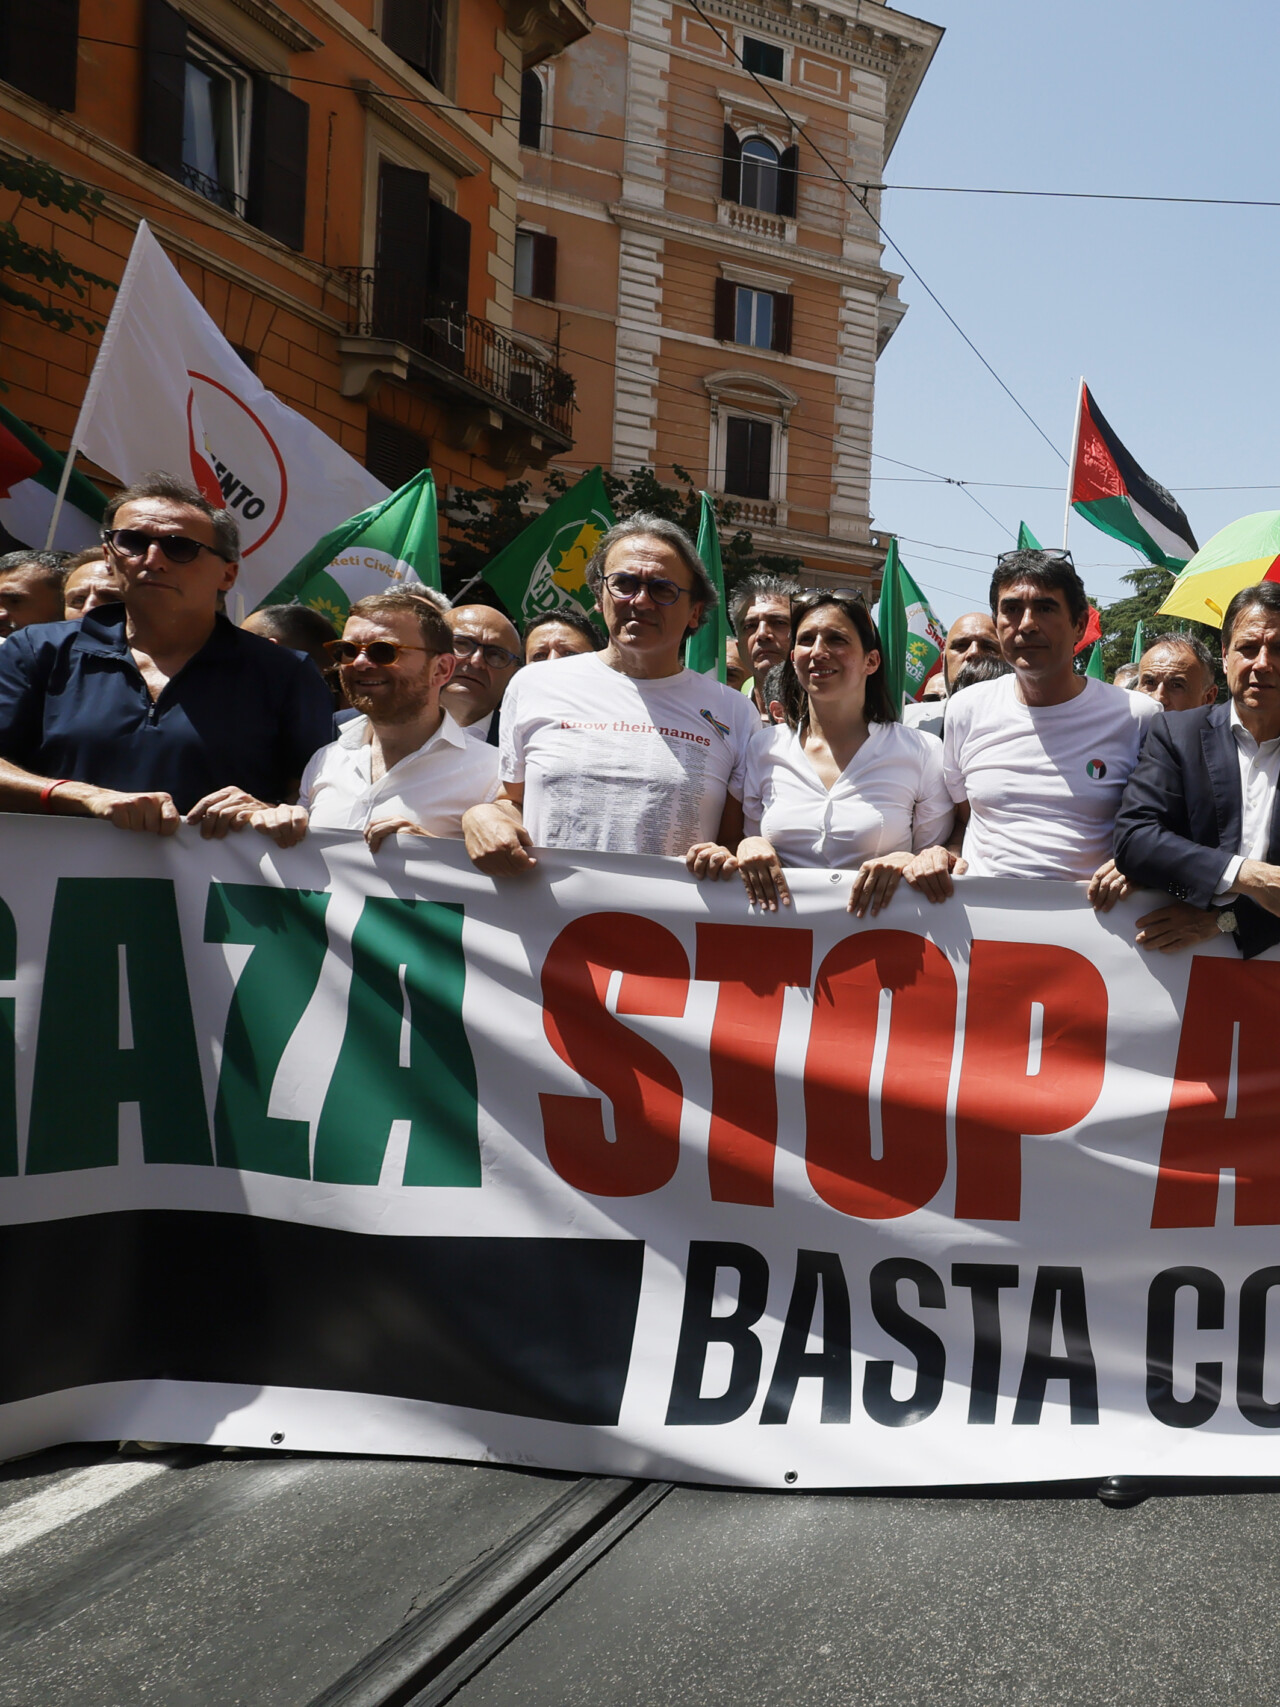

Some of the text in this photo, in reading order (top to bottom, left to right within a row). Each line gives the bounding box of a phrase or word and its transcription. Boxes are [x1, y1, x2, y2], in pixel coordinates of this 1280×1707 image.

[560, 719, 711, 747] Know their names
[0, 877, 482, 1188] AZA
[538, 911, 1109, 1222] STOP
[664, 1240, 1100, 1428] BASTA
